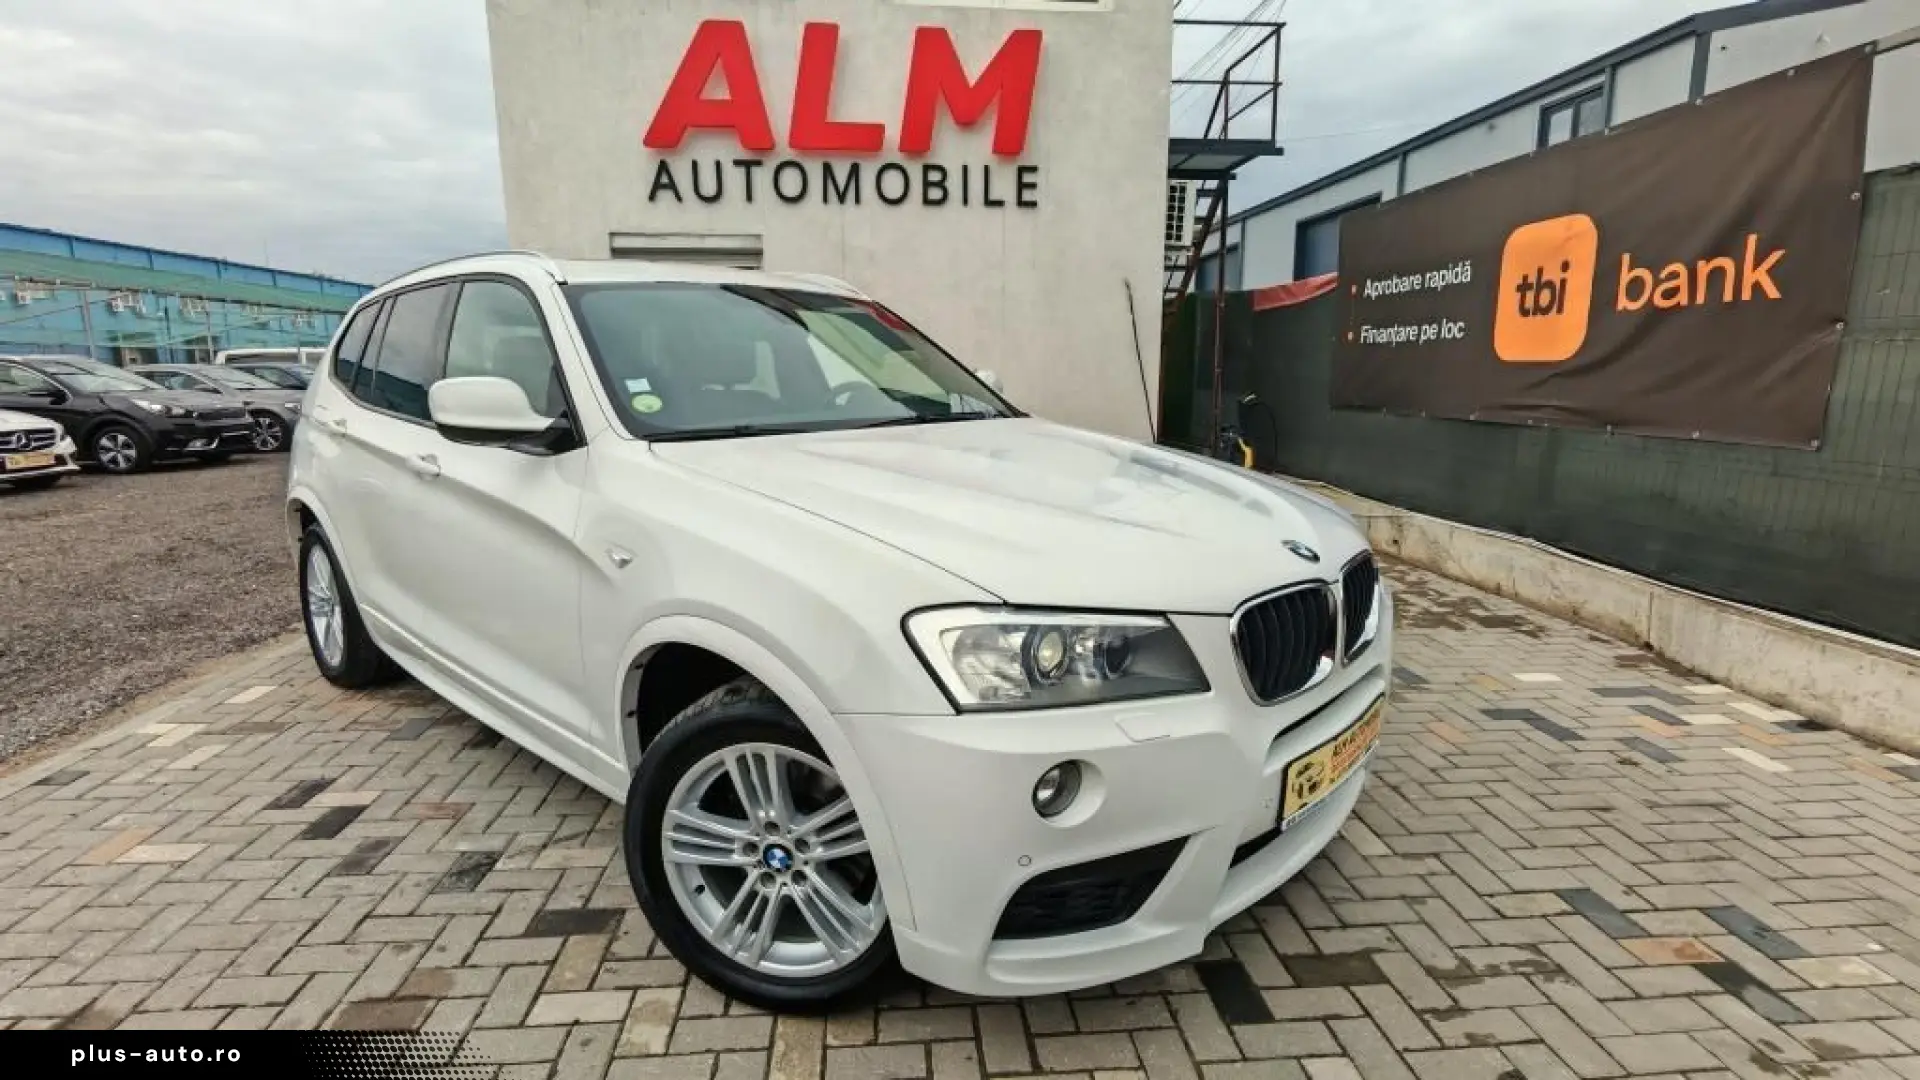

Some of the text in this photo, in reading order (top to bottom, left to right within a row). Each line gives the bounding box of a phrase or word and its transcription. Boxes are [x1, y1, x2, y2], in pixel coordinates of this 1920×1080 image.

[643, 19, 1043, 155] ALM
[648, 159, 1039, 208] AUTOMOBILE
[1362, 260, 1471, 300] Aprobare rapidă
[1515, 232, 1786, 317] tbi bank
[1419, 323, 1439, 345] pe
[1441, 318, 1465, 339] loc
